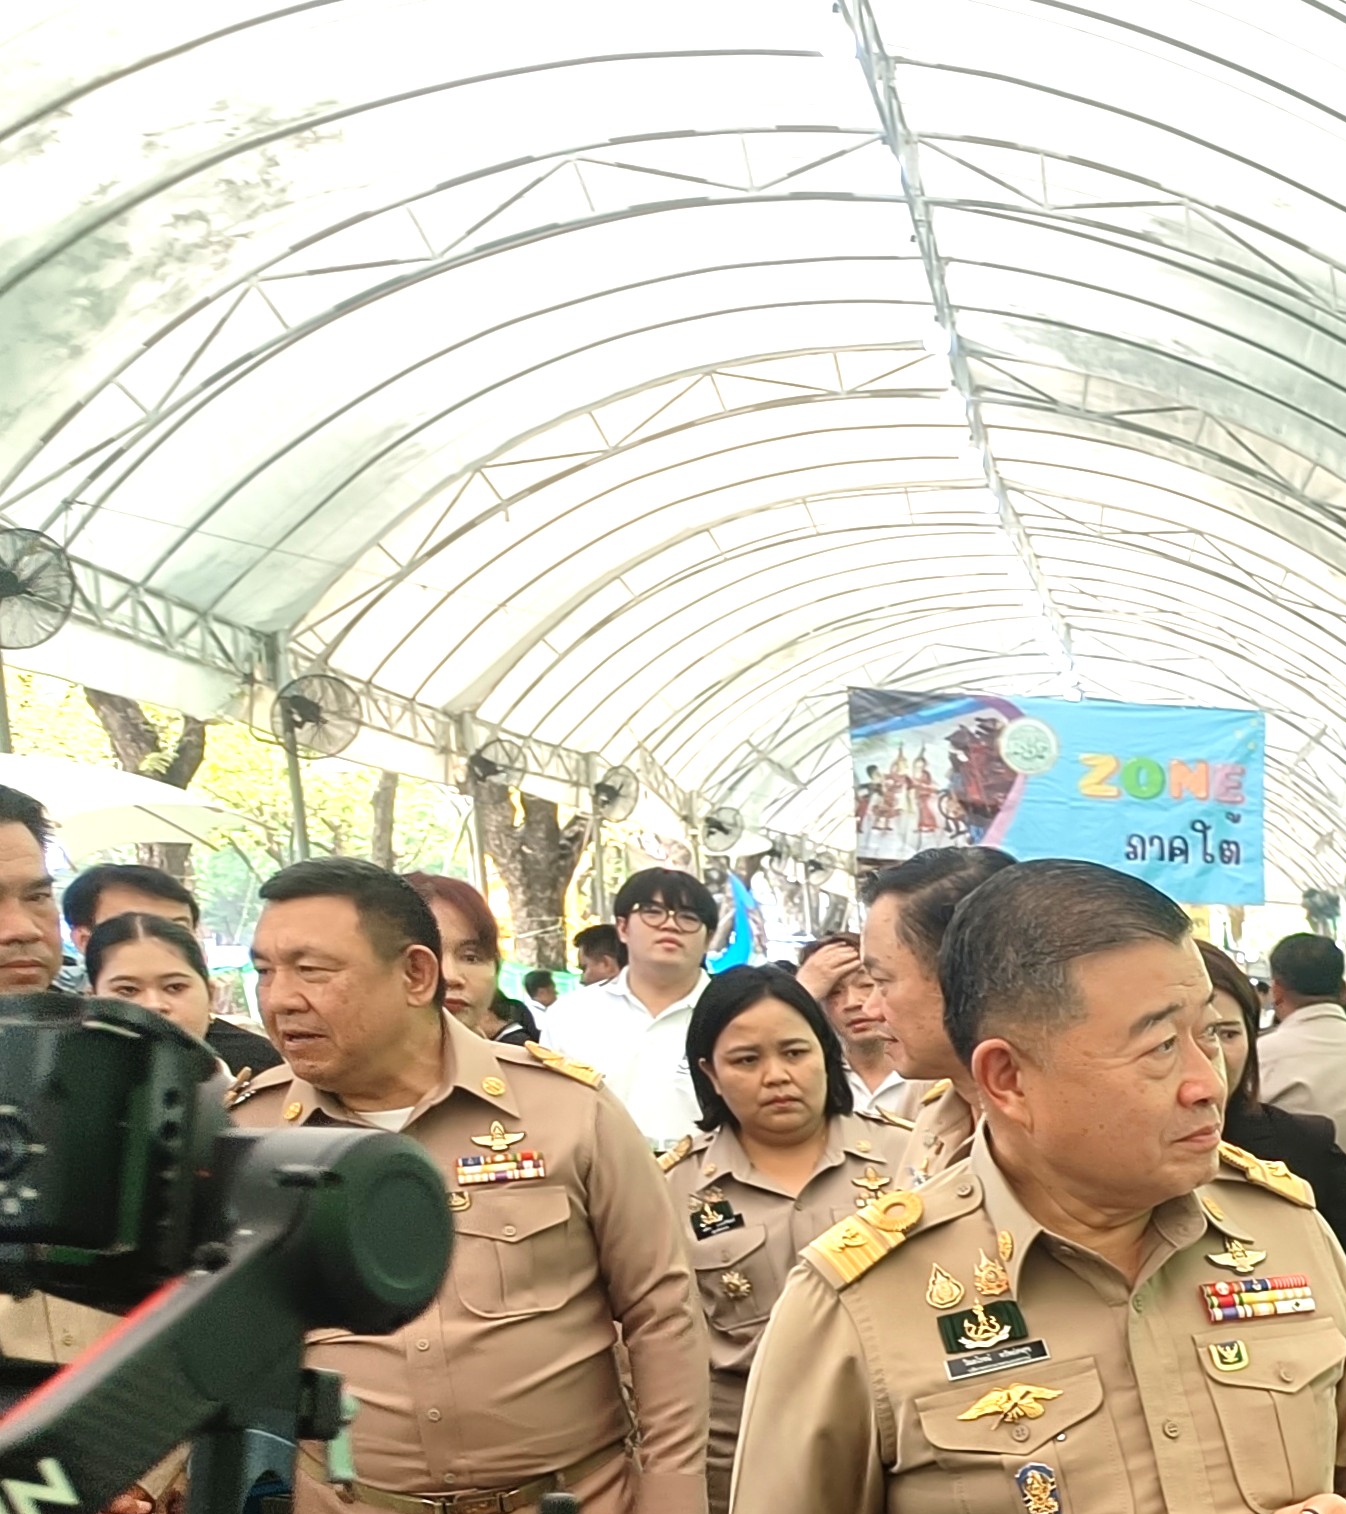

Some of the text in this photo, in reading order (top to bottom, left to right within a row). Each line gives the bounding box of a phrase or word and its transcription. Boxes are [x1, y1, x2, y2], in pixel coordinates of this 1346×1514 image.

[1078, 754, 1246, 804] ZONE
[1125, 811, 1241, 866] ภาคใต้
